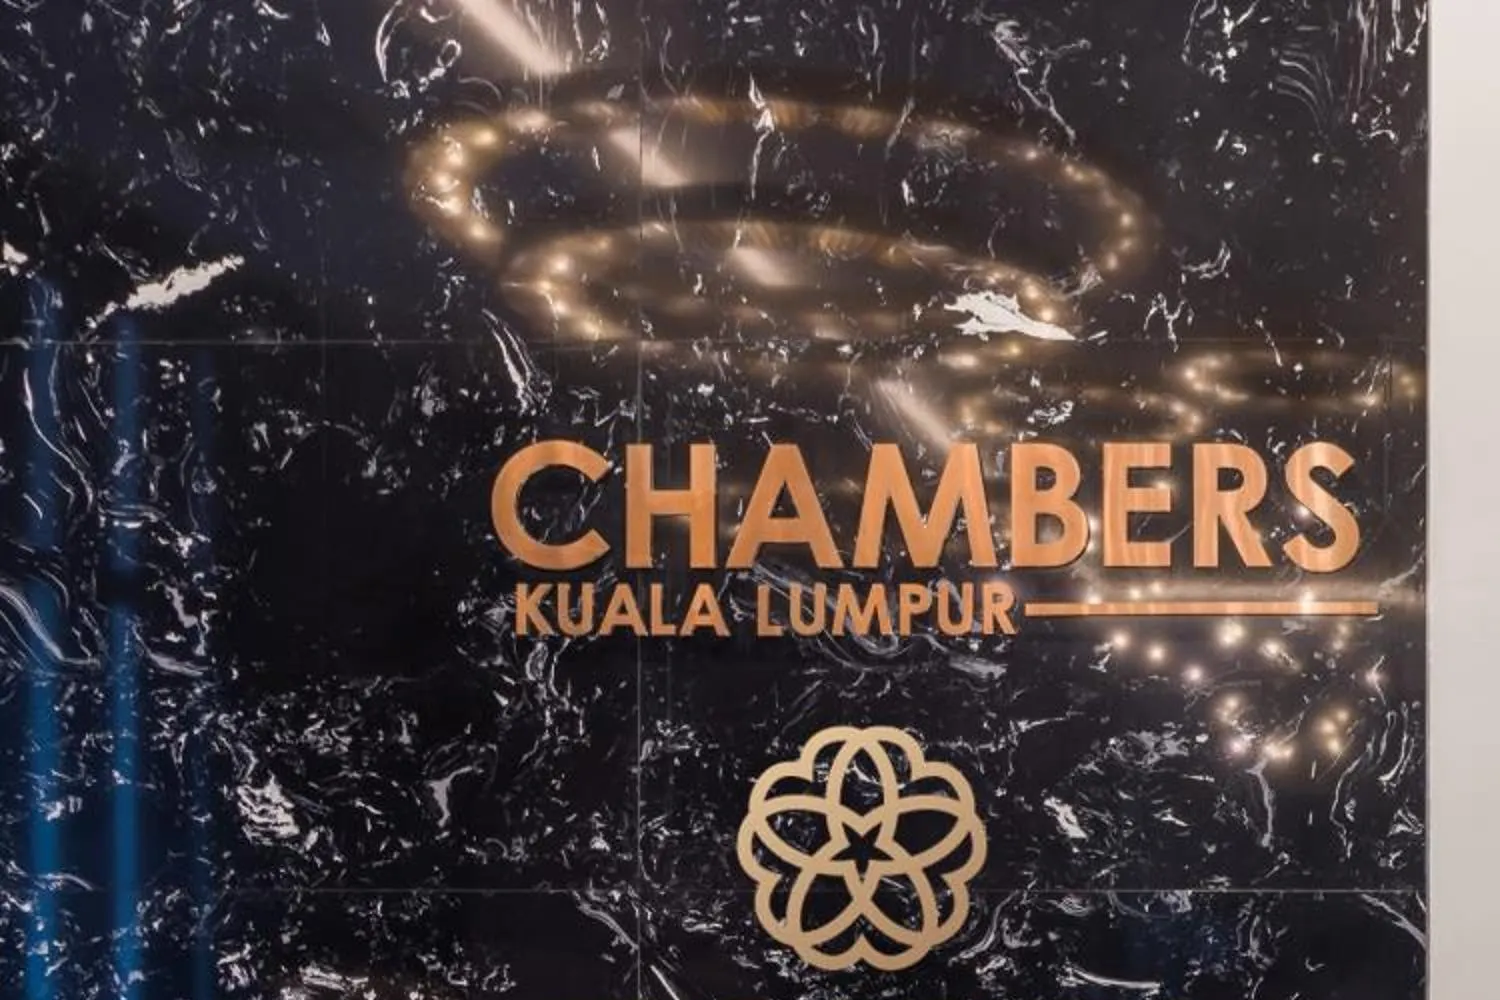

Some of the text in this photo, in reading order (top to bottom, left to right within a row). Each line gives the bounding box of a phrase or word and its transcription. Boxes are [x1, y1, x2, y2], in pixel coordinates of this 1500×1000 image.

[491, 440, 1361, 572] CHAMBERS
[512, 582, 1018, 638] KUALA LUMPUR
